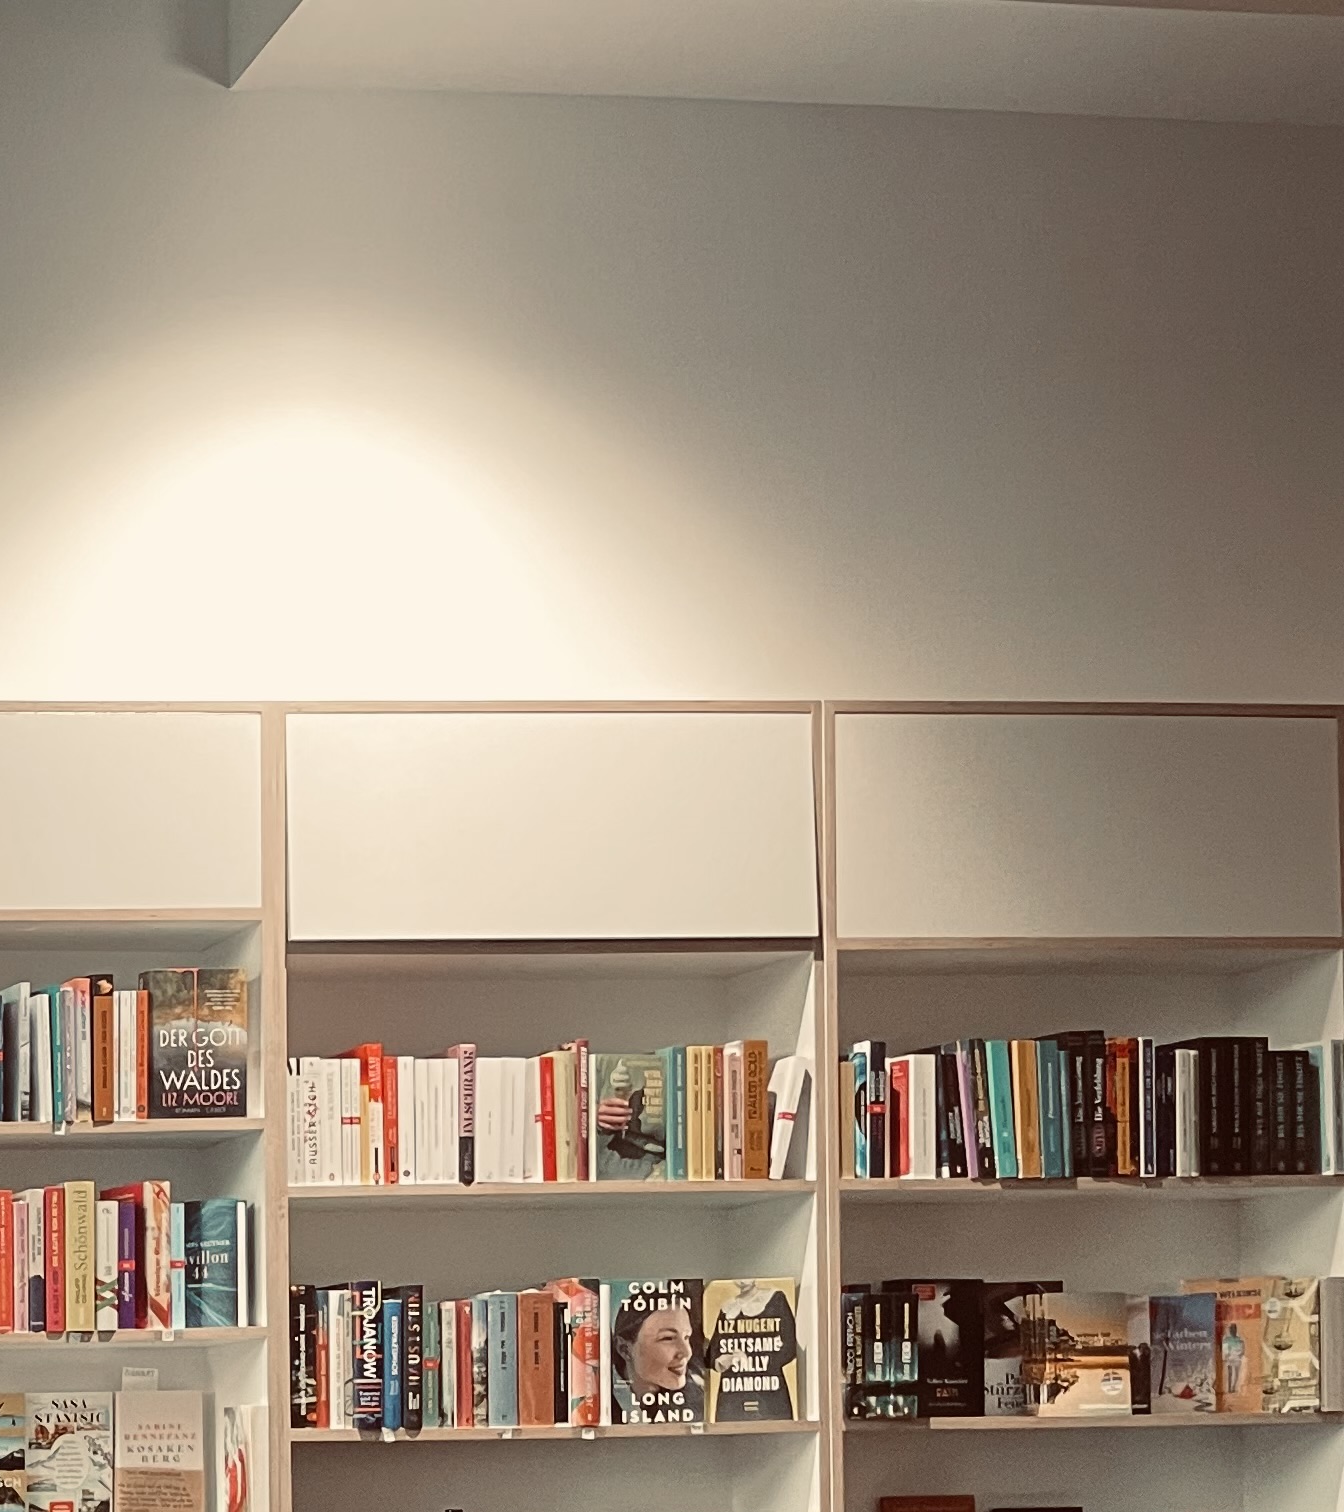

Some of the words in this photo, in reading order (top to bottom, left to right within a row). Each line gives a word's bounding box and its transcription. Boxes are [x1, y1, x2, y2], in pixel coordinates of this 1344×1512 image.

[159, 1028, 187, 1048] DER
[187, 1048, 215, 1068] DES
[159, 1068, 242, 1091] WALDES
[161, 1091, 178, 1106] LIZ
[181, 1091, 239, 1106] MOORE
[72, 1189, 88, 1272] Schönwald
[628, 1281, 684, 1295] COLM
[621, 1294, 692, 1312] TÓIBÍN
[362, 1286, 377, 1380] TROJANOW
[717, 1319, 736, 1334] LIZ
[736, 1318, 782, 1334] NUGENT
[719, 1337, 782, 1354] SELTSAME
[731, 1355, 769, 1372] SALLY
[721, 1376, 780, 1392] DIAMOND
[631, 1392, 686, 1406] LONG
[621, 1408, 695, 1424] ISLAND
[126, 1443, 196, 1454] KOSAKEN
[140, 1454, 181, 1464] BERG
